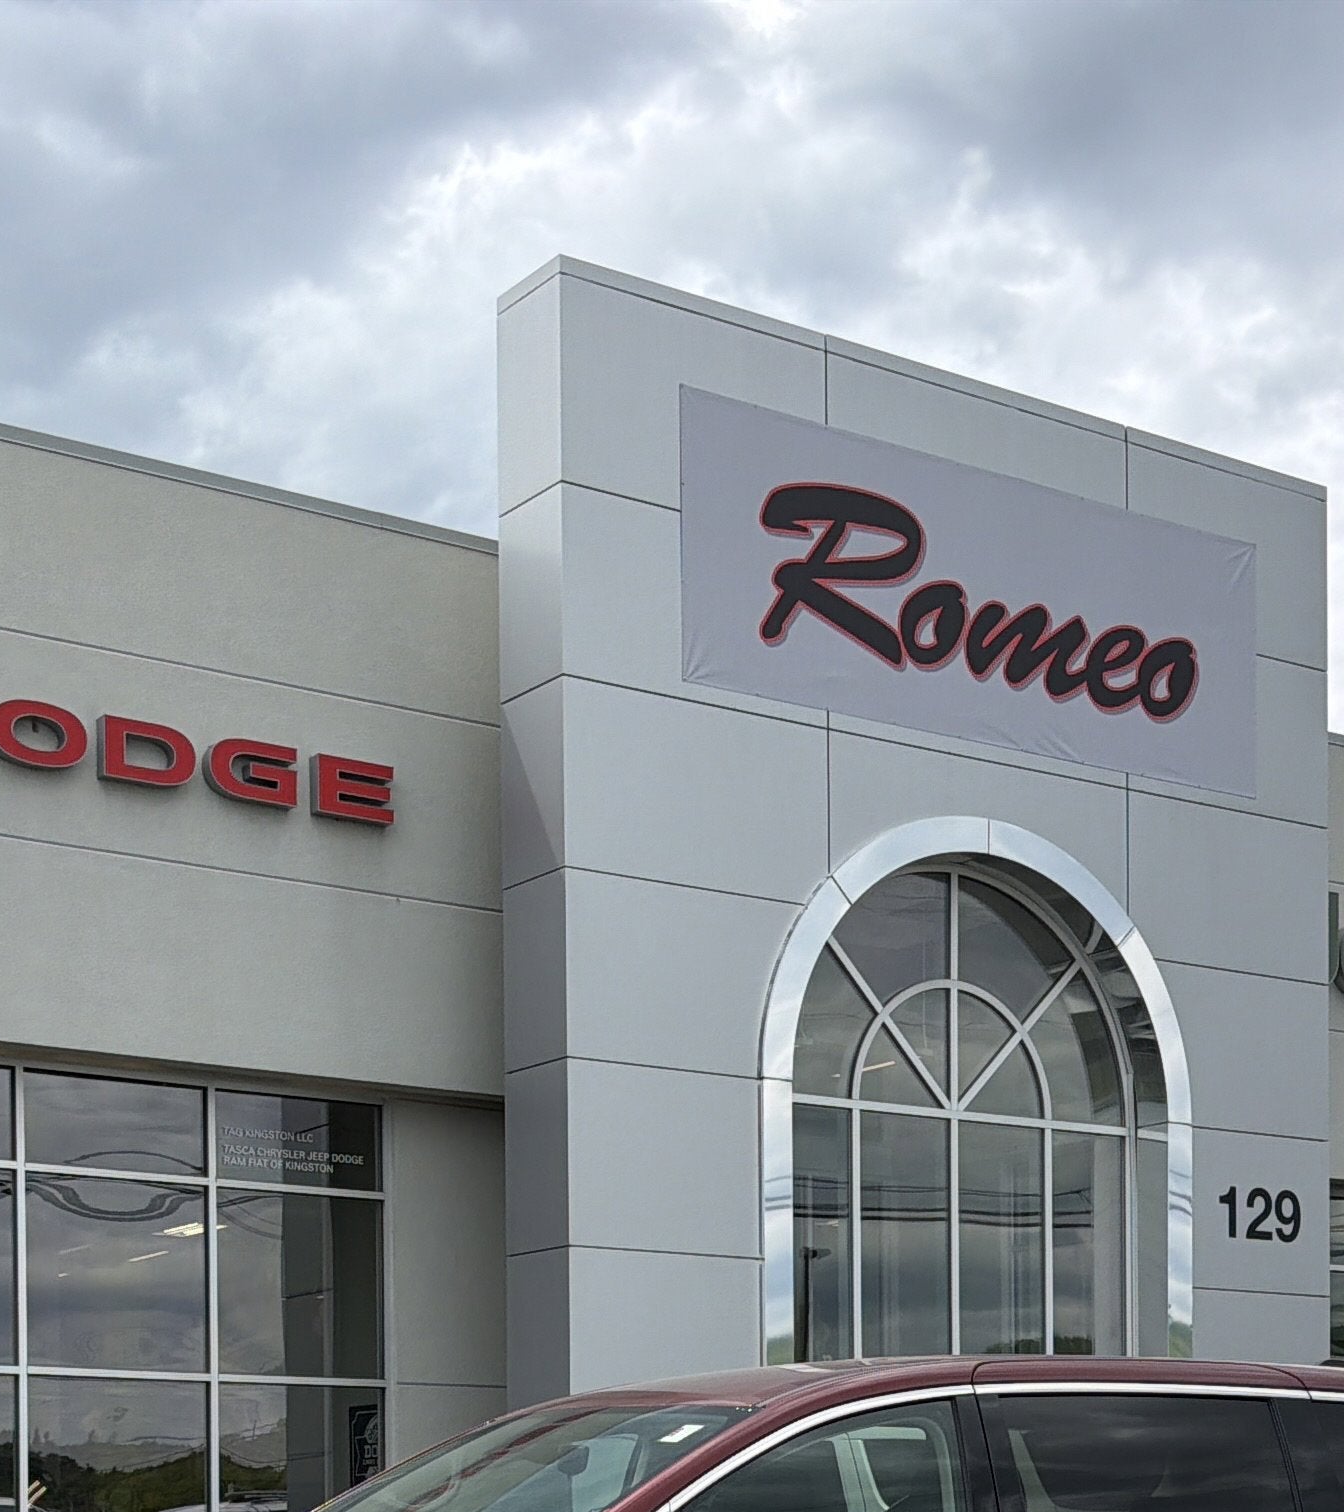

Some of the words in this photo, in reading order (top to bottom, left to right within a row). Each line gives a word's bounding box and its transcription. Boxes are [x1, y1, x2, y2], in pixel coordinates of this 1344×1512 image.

[759, 482, 1199, 724] Romeo
[244, 1128, 296, 1142] KINGSTON
[296, 1132, 314, 1143] LLC
[223, 1144, 255, 1156] TASCA
[256, 1146, 306, 1160] CHRYSLER
[307, 1151, 330, 1161] JEEP
[331, 1153, 364, 1165] DODGE
[223, 1156, 246, 1166] RAM
[248, 1157, 268, 1168] FIAT
[270, 1159, 283, 1169] OF
[285, 1160, 334, 1173] KINGSTON
[1219, 1186, 1301, 1243] 129
